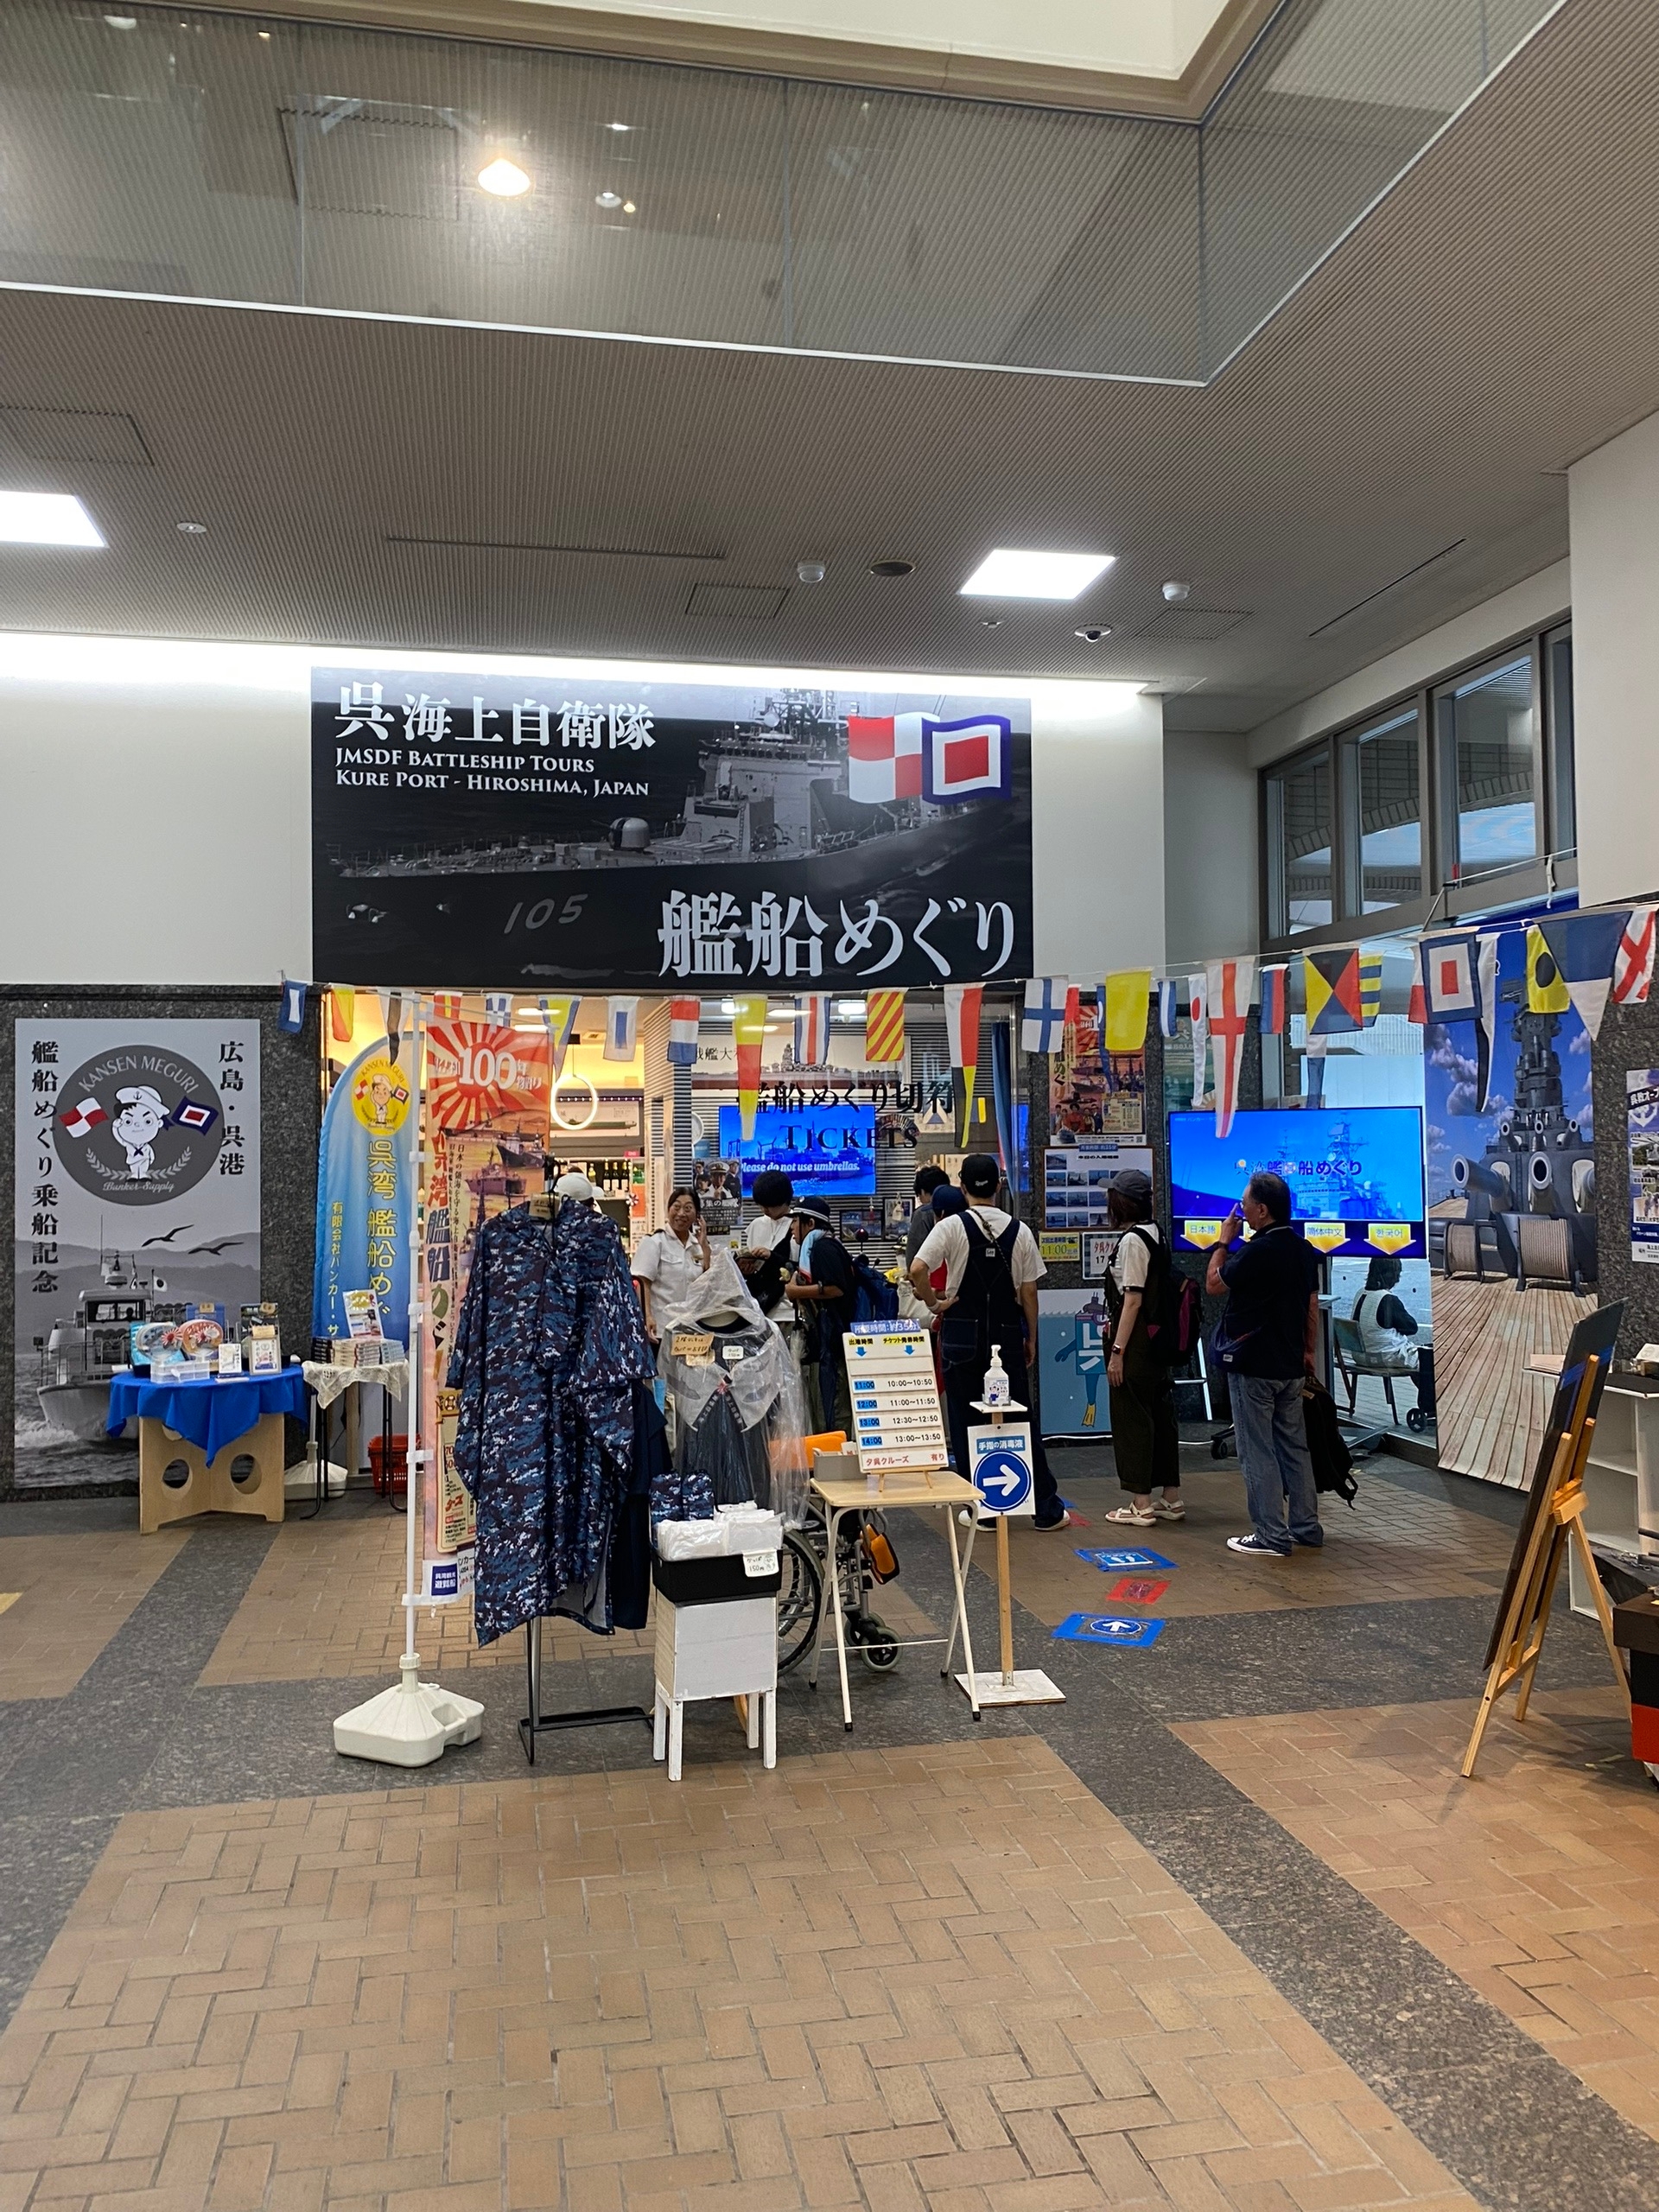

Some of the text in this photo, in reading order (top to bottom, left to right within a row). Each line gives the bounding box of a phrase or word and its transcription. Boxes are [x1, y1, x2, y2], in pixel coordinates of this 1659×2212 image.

[334, 681, 657, 750] 呉海上自衛隊
[335, 747, 402, 767] JMSDF
[504, 893, 588, 934] 105
[657, 889, 1015, 978] 艦船めぐり
[79, 1055, 200, 1094] KANSEN MEGURI
[219, 1040, 246, 1175] 広島・呉港
[31, 1041, 60, 1294] 艦船めぐり乗船記念
[741, 1161, 766, 1173] lease
[780, 1162, 796, 1173] not
[798, 1163, 813, 1172] use
[814, 1160, 861, 1172] umbrellas.
[1189, 1224, 1217, 1234] 日本語
[1306, 1226, 1343, 1237] 简体中文
[1376, 1228, 1404, 1239] 한국어
[855, 1380, 875, 1389] 11:00
[856, 1400, 878, 1408] 12:00
[859, 1418, 880, 1427] 13:00
[861, 1436, 883, 1446] 14:00
[978, 1439, 1024, 1451] 手指の消毒液
[866, 1452, 944, 1465] 夕呉クルーズ 有り
